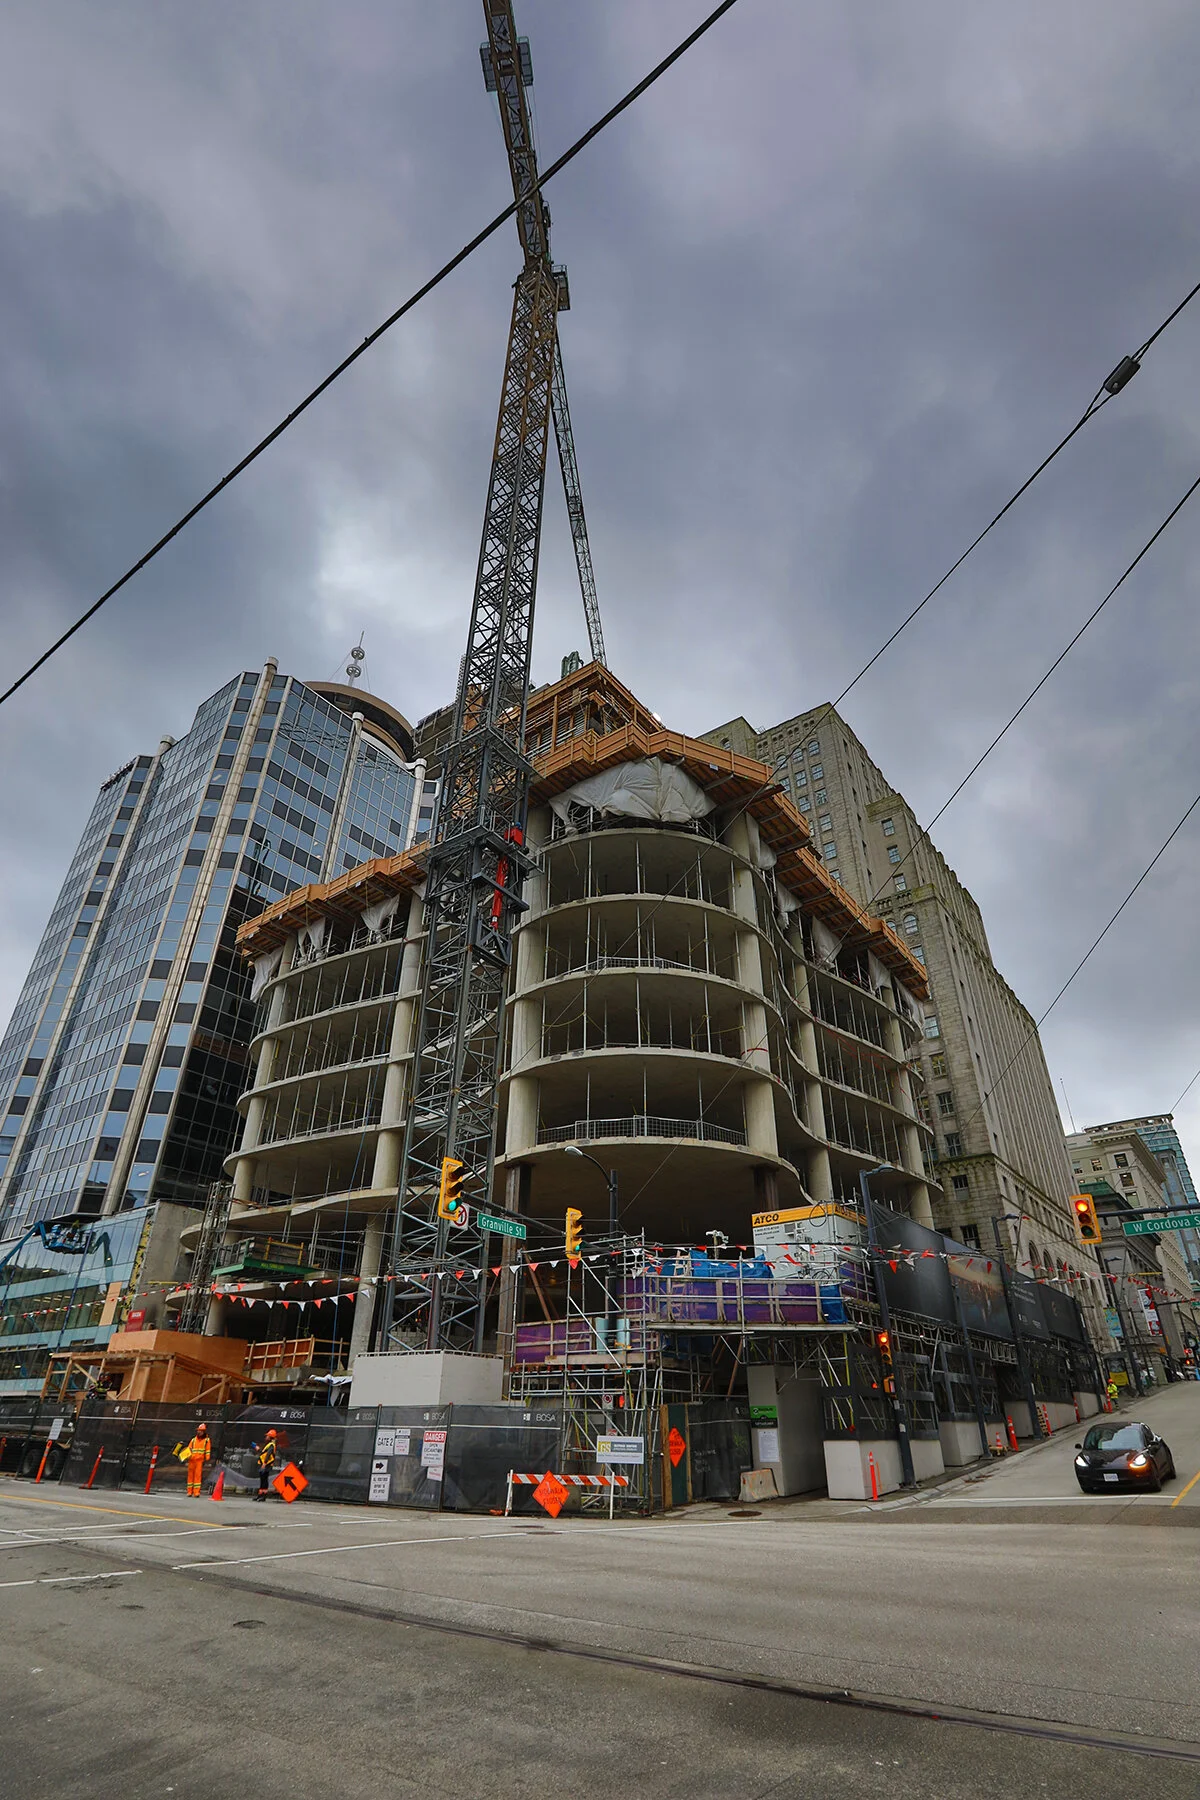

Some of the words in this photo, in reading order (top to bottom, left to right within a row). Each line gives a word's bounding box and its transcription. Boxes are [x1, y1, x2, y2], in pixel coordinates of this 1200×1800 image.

[754, 1213, 779, 1225] ATCO
[481, 1217, 513, 1234] Granville
[515, 1226, 522, 1237] St
[1133, 1222, 1142, 1233] W
[1147, 1218, 1190, 1231] Cordova
[1194, 1216, 1200, 1226] S
[206, 1409, 222, 1417] BOSA
[289, 1411, 306, 1419] BOSA
[431, 1412, 445, 1420] BOSA
[536, 1413, 556, 1421] BOSA
[425, 1432, 445, 1441] DANGER
[377, 1437, 389, 1447] GATE
[389, 1438, 394, 1447] 2
